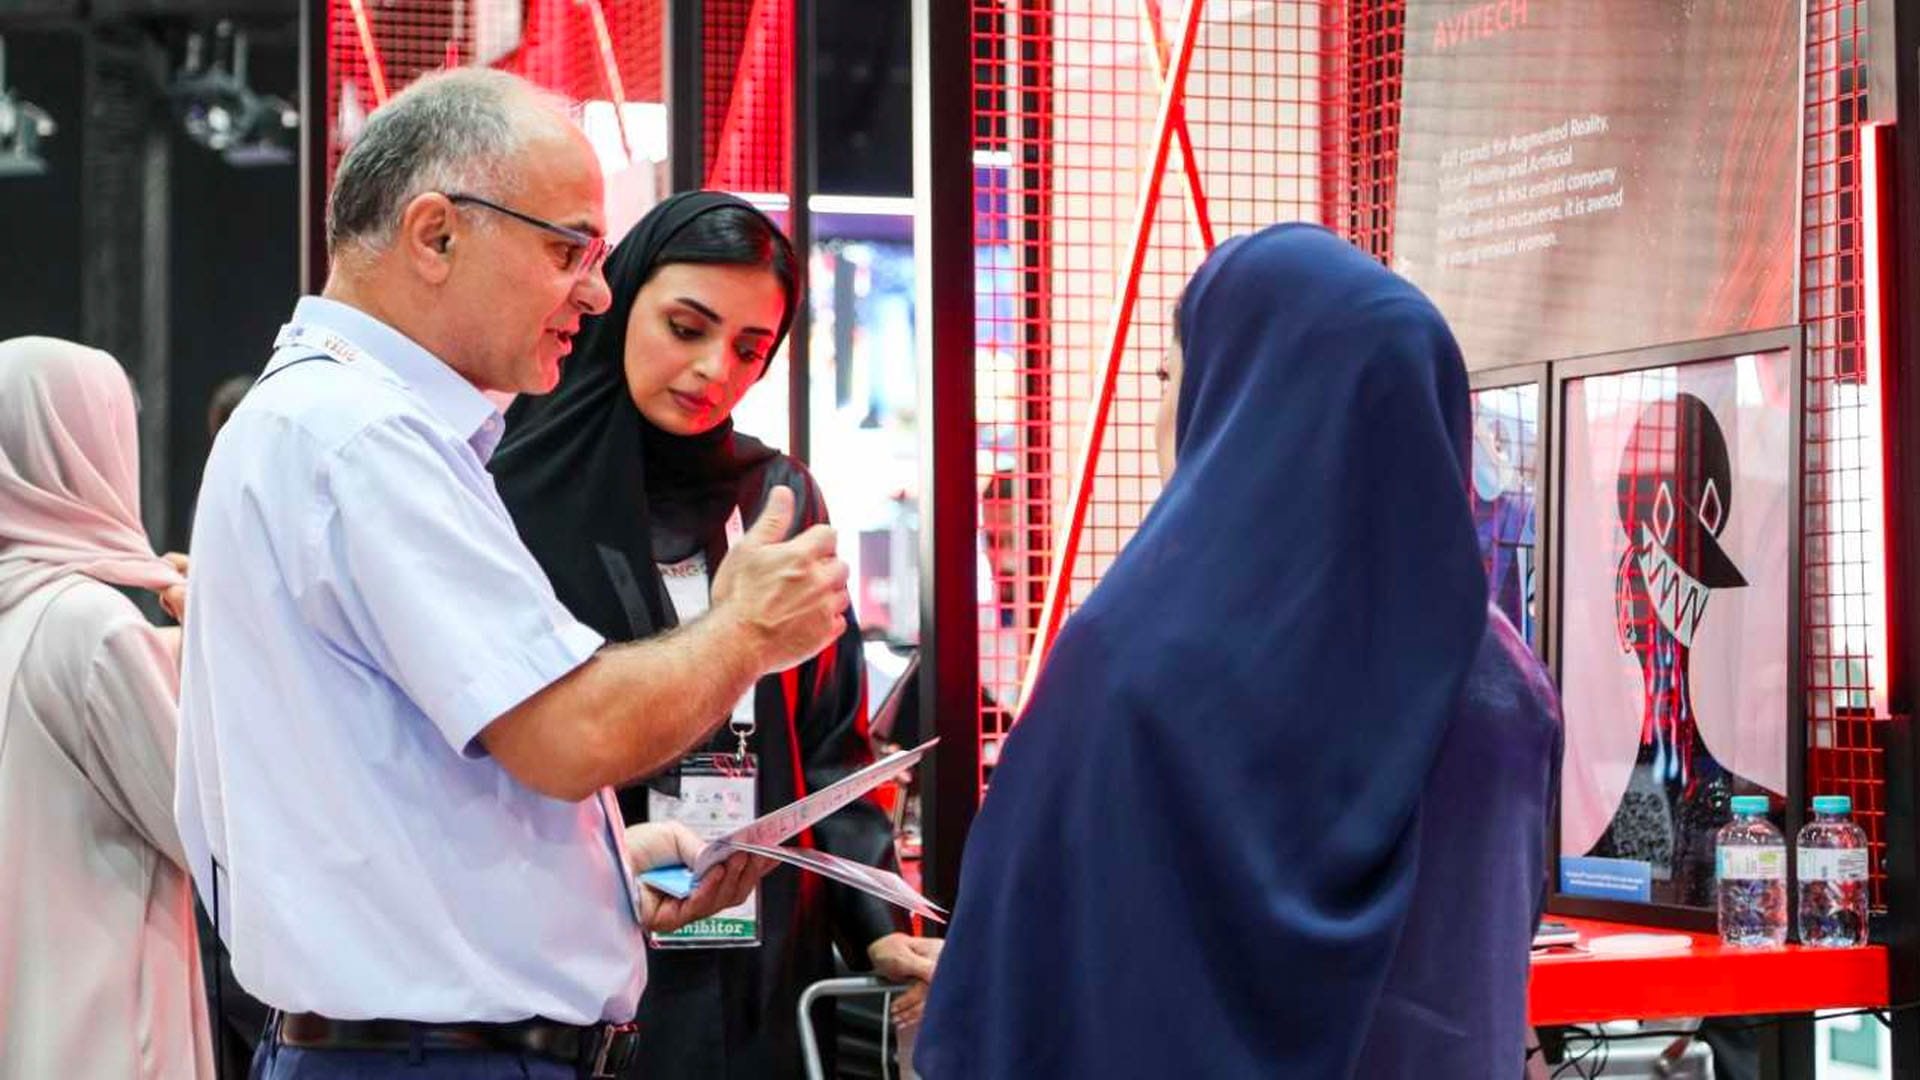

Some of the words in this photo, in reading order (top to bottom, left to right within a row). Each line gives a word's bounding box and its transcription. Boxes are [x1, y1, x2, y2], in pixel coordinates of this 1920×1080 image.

[1508, 119, 1569, 153] Augmented
[1508, 156, 1528, 178] and
[1567, 167, 1617, 193] company
[1564, 197, 1574, 216] it
[1575, 194, 1585, 215] is
